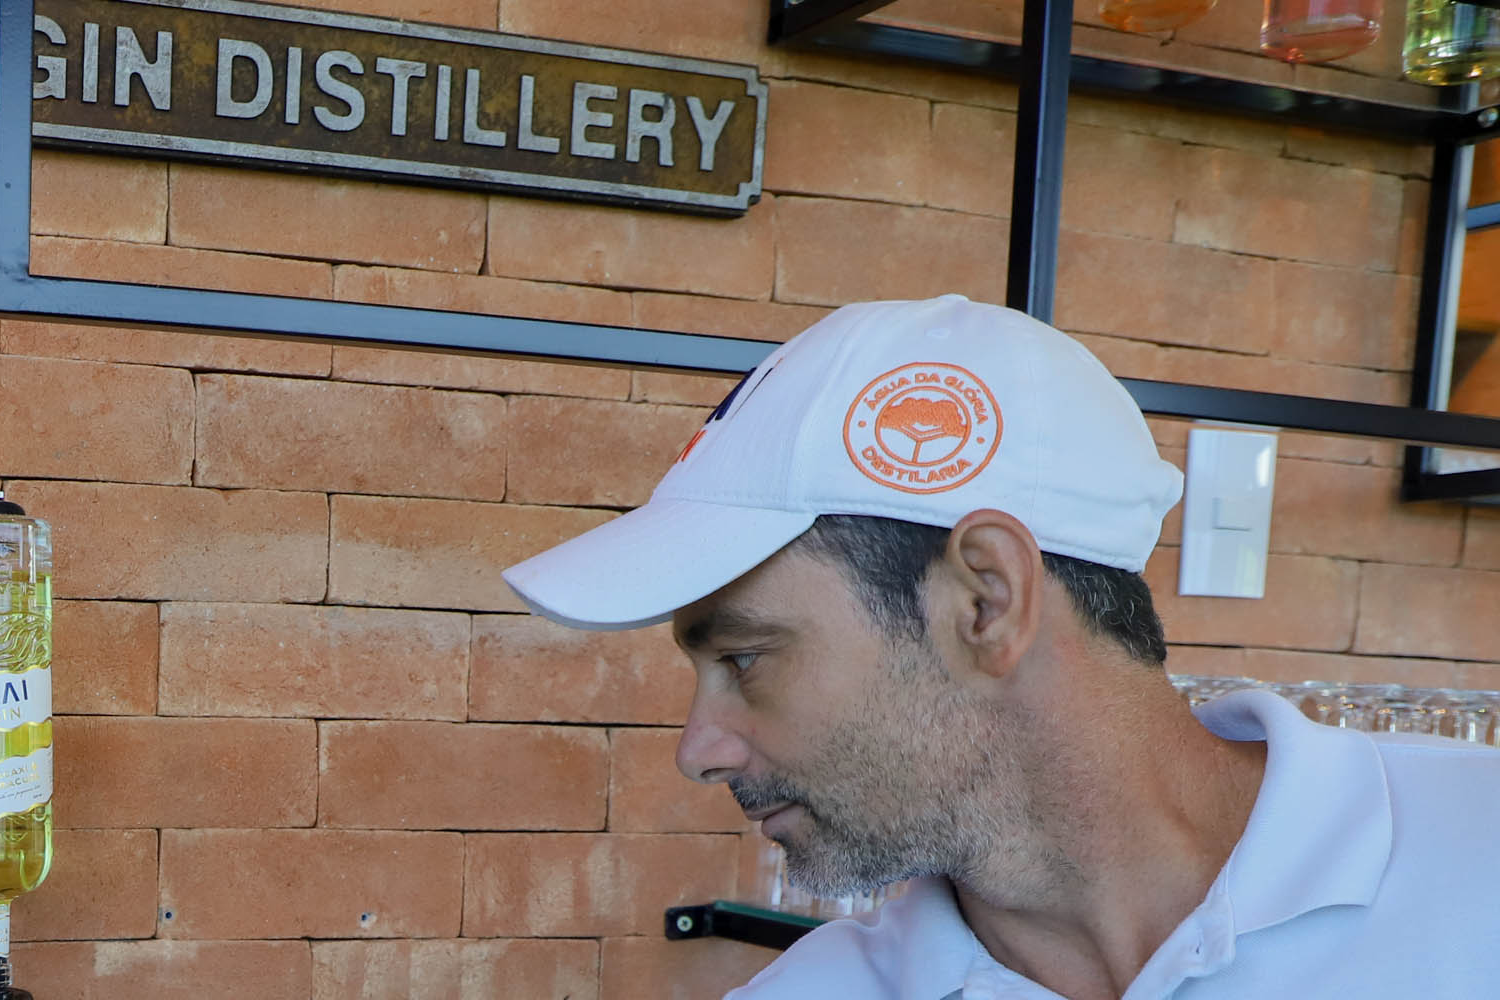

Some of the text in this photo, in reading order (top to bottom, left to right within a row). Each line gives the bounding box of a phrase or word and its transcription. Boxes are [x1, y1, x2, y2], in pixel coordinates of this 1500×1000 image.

[33, 14, 737, 172] GIN DISTILLERY
[915, 372, 941, 385] DA
[861, 444, 973, 483] DESTILARIA
